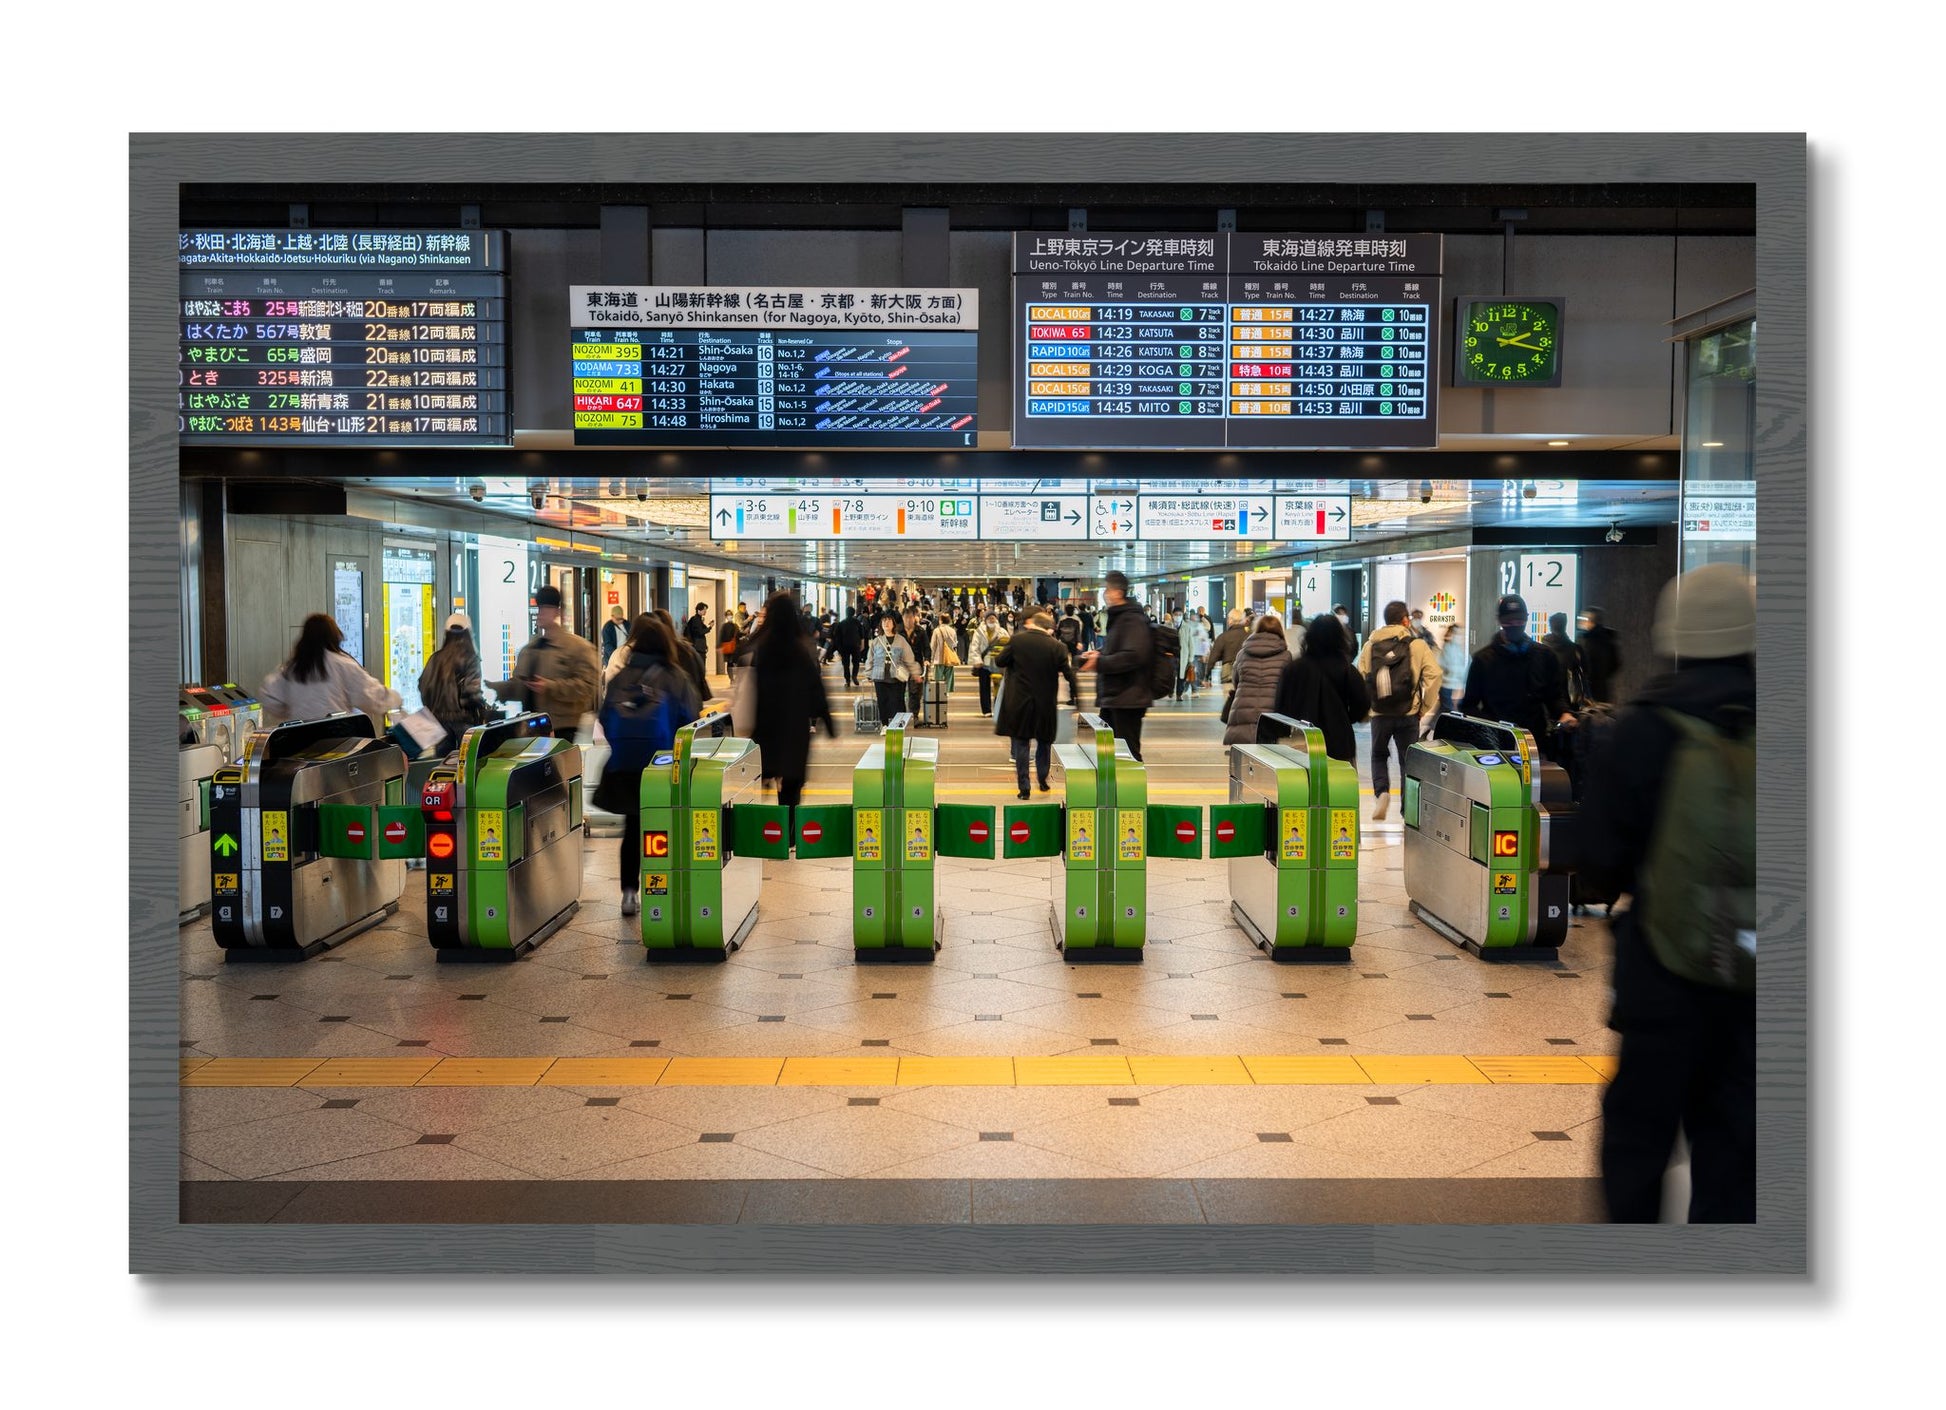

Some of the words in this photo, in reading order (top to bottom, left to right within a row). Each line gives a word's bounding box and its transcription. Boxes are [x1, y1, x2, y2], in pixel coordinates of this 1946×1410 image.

[1029, 239, 1214, 257] 上野東京ライン発車時刻
[1263, 239, 1406, 258] 東海道線発車時刻
[359, 254, 375, 265] (via
[378, 254, 417, 266] Nagano)
[419, 254, 471, 264] Shinkansen
[1029, 259, 1097, 272] Ueno-Tōkyō
[1100, 261, 1123, 270] Line
[1127, 261, 1184, 272] Departure
[1188, 261, 1214, 270] Time
[1253, 260, 1298, 271] Tōkaidō
[1301, 261, 1325, 271] Line
[1328, 261, 1386, 273] Departure
[1389, 261, 1415, 271] Time
[312, 287, 349, 295] Destination
[1107, 282, 1122, 290] 時刻
[1138, 291, 1177, 299] Destination
[265, 301, 298, 316] 25号
[1031, 309, 1066, 319] LOCAL
[1097, 308, 1133, 320] 14:19
[1139, 310, 1175, 318] TAKASAKI
[1199, 309, 1206, 320] 7
[1502, 308, 1516, 318] 12
[589, 310, 643, 323] Tōkaidō,
[646, 311, 684, 324] Sanyō
[687, 311, 758, 323] Shinkansen
[763, 311, 787, 324] (for
[790, 313, 841, 326] Nagoya,
[844, 313, 884, 326] Kyōto,
[888, 311, 961, 325] Shin-Ōsaka)
[1240, 309, 1263, 321] 普通
[1299, 309, 1334, 321] 14:27
[1341, 309, 1365, 321] 熱海
[1488, 312, 1500, 321] 11
[187, 324, 248, 339] はくたか
[256, 324, 299, 340] 567号
[299, 324, 332, 340] 敦賀
[1032, 327, 1066, 337] TOKIWA
[1071, 327, 1085, 337] 65
[1097, 327, 1133, 339] 14:23
[1139, 328, 1174, 338] KATSUTA
[1475, 322, 1489, 332] 10
[1299, 328, 1334, 340] 14:30
[1340, 328, 1364, 340] 品川
[1468, 337, 1477, 347] 9
[1539, 337, 1548, 347] 3
[187, 347, 250, 362] やまびこ
[267, 348, 299, 362] 65号
[300, 347, 331, 364] 盛岡
[574, 345, 613, 354] NOZOMI
[615, 347, 639, 358] 395
[650, 347, 684, 358] 14:21
[698, 345, 753, 355] Shin-Ōsaka
[759, 347, 772, 359] 16
[1032, 346, 1066, 356] RAPID
[1097, 346, 1133, 357] 14:26
[1139, 347, 1173, 356] KATSUTA
[1299, 346, 1334, 358] 14:37
[1340, 346, 1364, 359] 熱海
[575, 362, 613, 371] KODAMA
[615, 364, 639, 375] 733
[650, 364, 685, 375] 14:27
[699, 363, 737, 373] Nagoya
[759, 364, 773, 376] 19
[1031, 365, 1066, 375] LOCAL
[1097, 364, 1132, 376] 14:29
[1138, 365, 1173, 376] KOGA
[1239, 364, 1262, 376] 特急
[1298, 365, 1333, 377] 14:43
[1340, 365, 1363, 377] 品川
[1502, 366, 1512, 376] 6
[189, 370, 219, 385] とき
[258, 370, 300, 385] 325号
[300, 370, 333, 387] 新潟
[575, 380, 613, 388] NOZOMI
[620, 381, 634, 392] 41
[651, 381, 686, 393] 14:30
[699, 380, 735, 389] Hakata
[759, 382, 773, 393] 18
[1097, 383, 1132, 395] 14:39
[1138, 385, 1173, 393] TAKASAKI
[1298, 384, 1333, 396] 14:50
[1339, 384, 1375, 396] 小田原
[189, 393, 251, 409] はやぶさ
[268, 394, 300, 409] 27号
[300, 393, 349, 410] 新青森
[577, 396, 612, 405] HIKARI
[616, 398, 640, 409] 647
[651, 398, 686, 410] 14:33
[699, 396, 754, 406] Shin-Ōsaka
[760, 399, 772, 410] 15
[1031, 402, 1065, 412] RAPID
[1096, 401, 1132, 413] 14:45
[1138, 402, 1170, 413] MITO
[1298, 402, 1333, 414] 14:53
[1339, 402, 1362, 414] 品川
[260, 417, 301, 432] 143号
[301, 416, 365, 433] 仙台・山形
[576, 414, 614, 422] NOZOMI
[621, 415, 637, 426] 75
[652, 415, 687, 427] 14:48
[700, 413, 750, 423] Hiroshima
[1285, 501, 1313, 511] 京葉線
[798, 513, 818, 521] 山手線
[844, 513, 889, 521] 上野東京ライン
[941, 519, 969, 528] 新幹線
[455, 553, 462, 592] 1
[503, 560, 516, 583] 2
[1307, 577, 1317, 592] 4
[1193, 585, 1199, 597] 6
[425, 796, 441, 805] QR
[646, 834, 667, 855] IC
[1495, 834, 1517, 854] IC
[223, 908, 229, 916] 8
[272, 908, 278, 916] 7
[488, 909, 494, 917] 6
[653, 909, 659, 917] 6
[1339, 907, 1345, 915] 2
